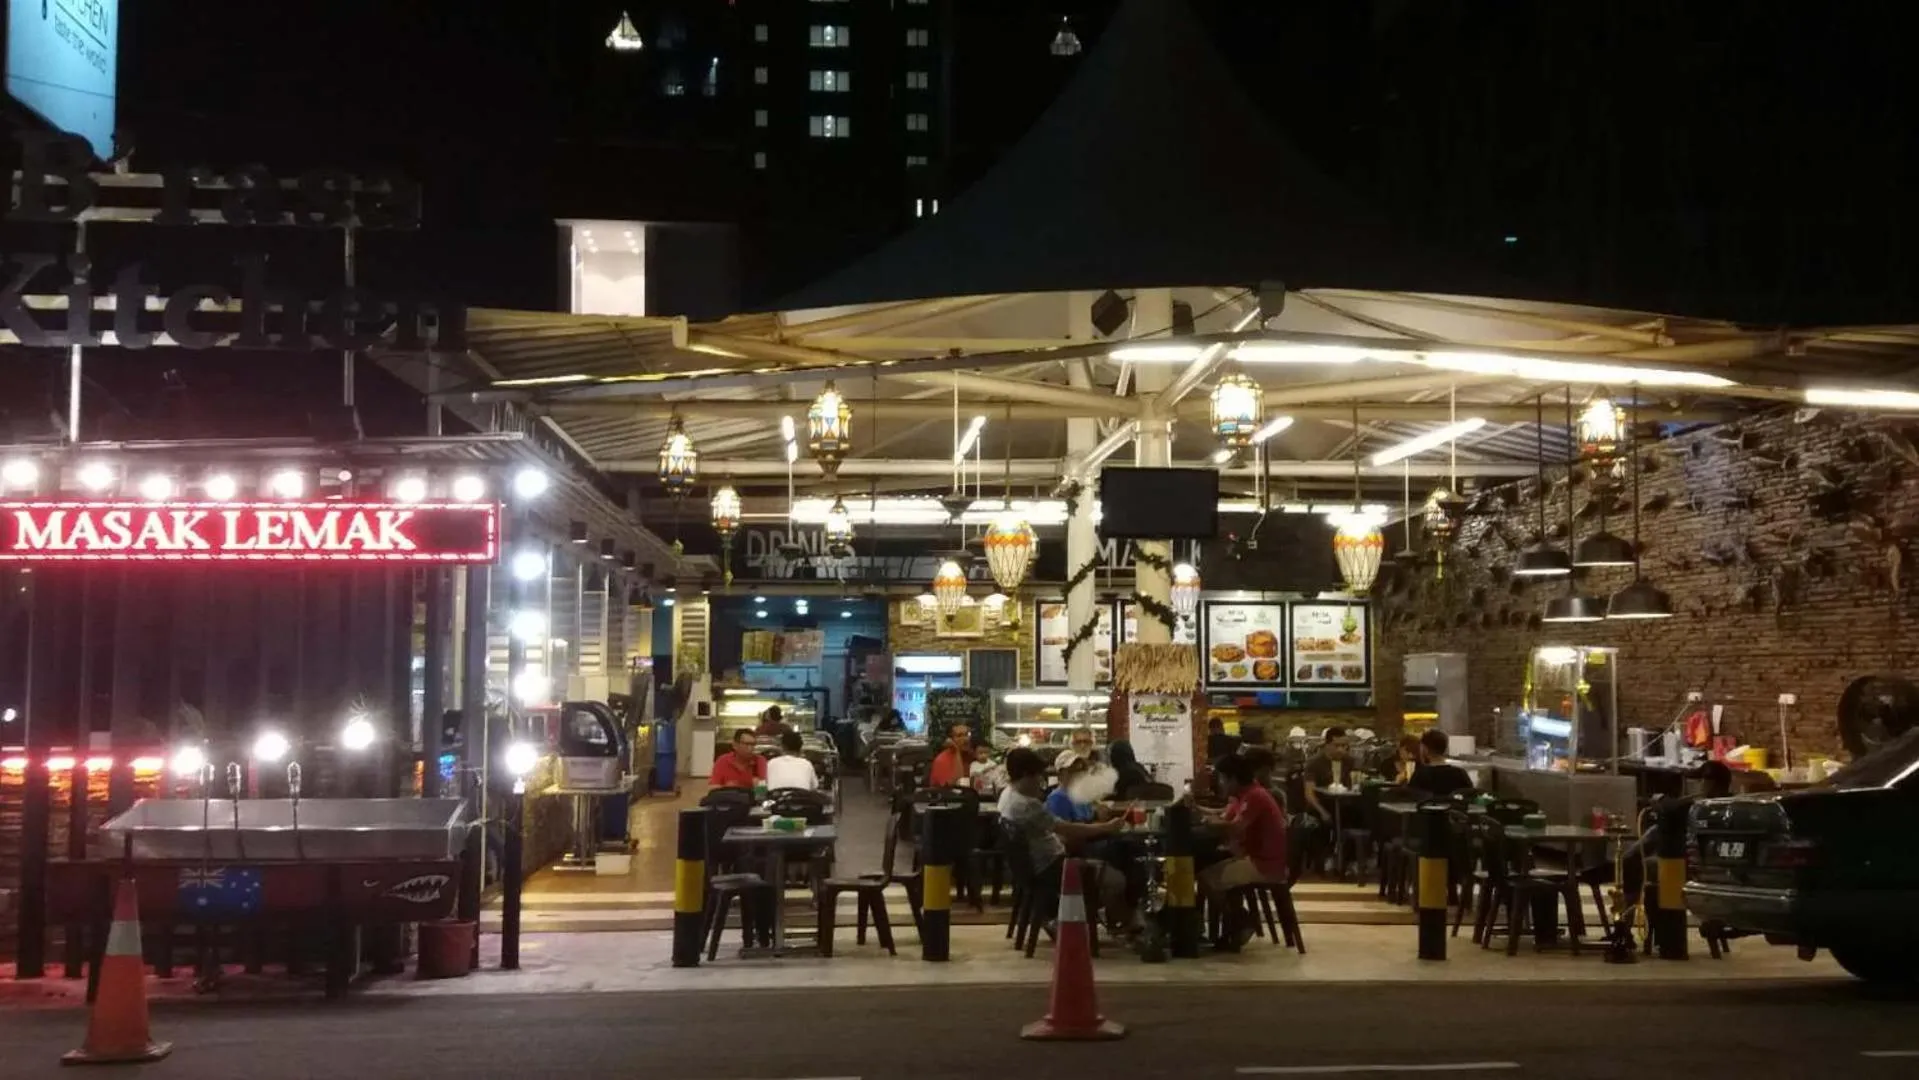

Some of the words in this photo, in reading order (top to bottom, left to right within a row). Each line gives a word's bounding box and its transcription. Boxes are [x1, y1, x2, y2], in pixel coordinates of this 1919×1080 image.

[13, 509, 209, 551] MASAK
[220, 509, 416, 551] LEMAK
[746, 530, 856, 568] DRNK
